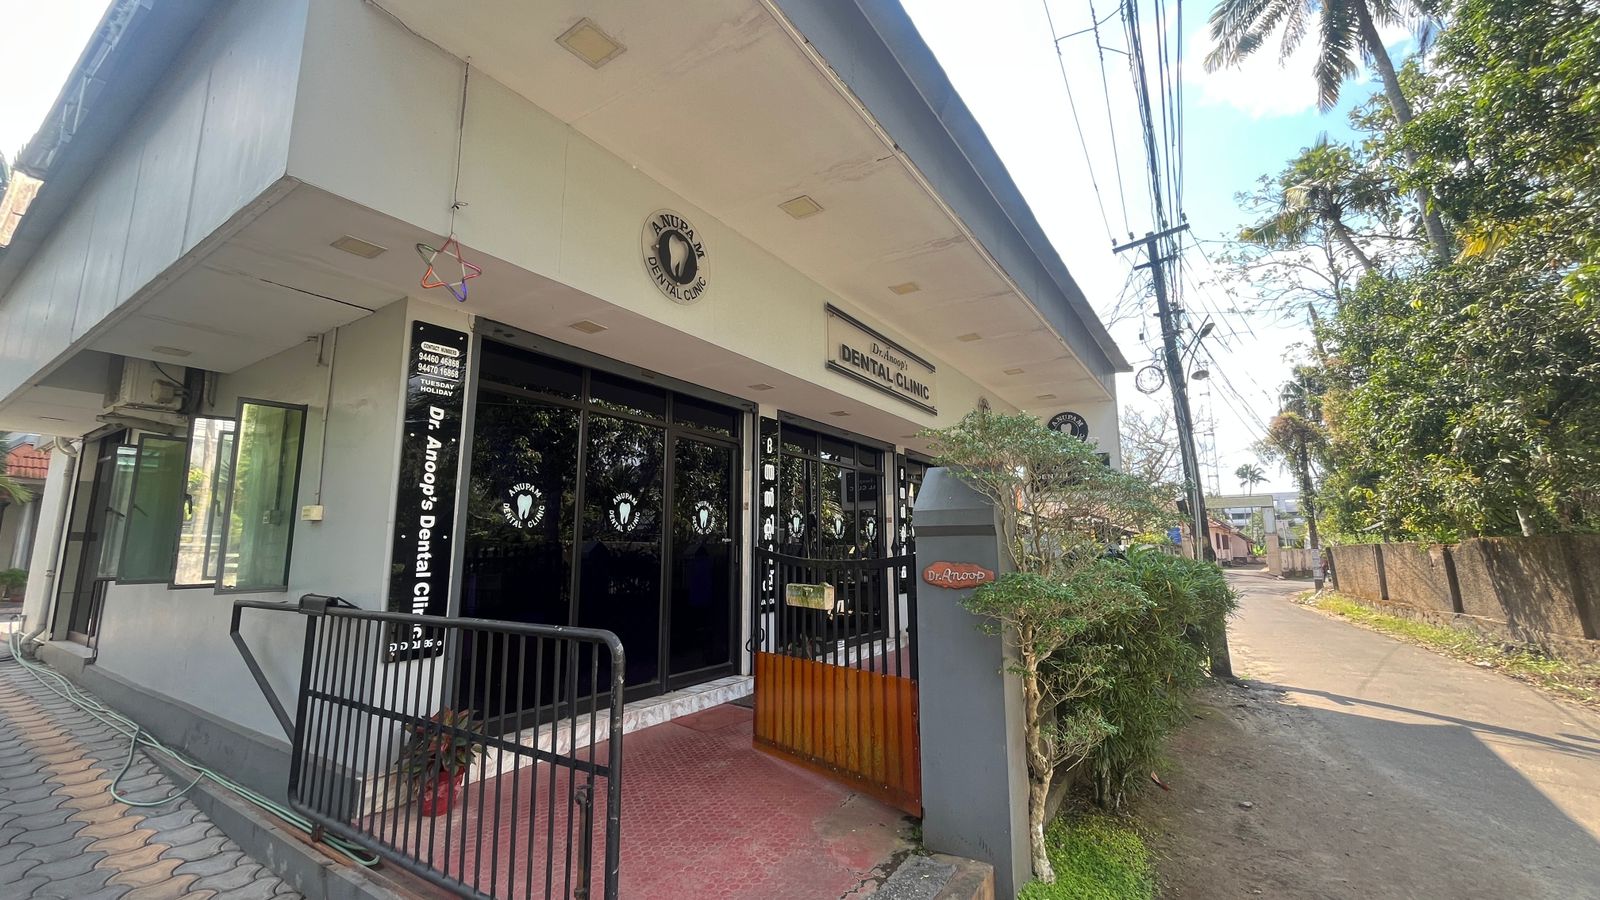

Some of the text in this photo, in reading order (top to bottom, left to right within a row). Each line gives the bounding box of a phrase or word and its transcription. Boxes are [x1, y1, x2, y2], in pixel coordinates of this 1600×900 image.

[652, 214, 705, 259] ANUPAM
[648, 256, 706, 301] DENTAL CLINIC
[420, 378, 455, 390] TUESDAY
[841, 343, 930, 400] DENTAL CLINIC
[420, 386, 454, 397] HOLIDAY
[428, 405, 445, 430] Dr.
[419, 435, 442, 511] Anoop's
[508, 483, 542, 498] ANUPAM
[612, 492, 638, 506] ANUPAM
[503, 503, 546, 529] DENTAL CLINIC
[609, 509, 641, 533] DENTAL CLINIC
[415, 515, 436, 578] Dental
